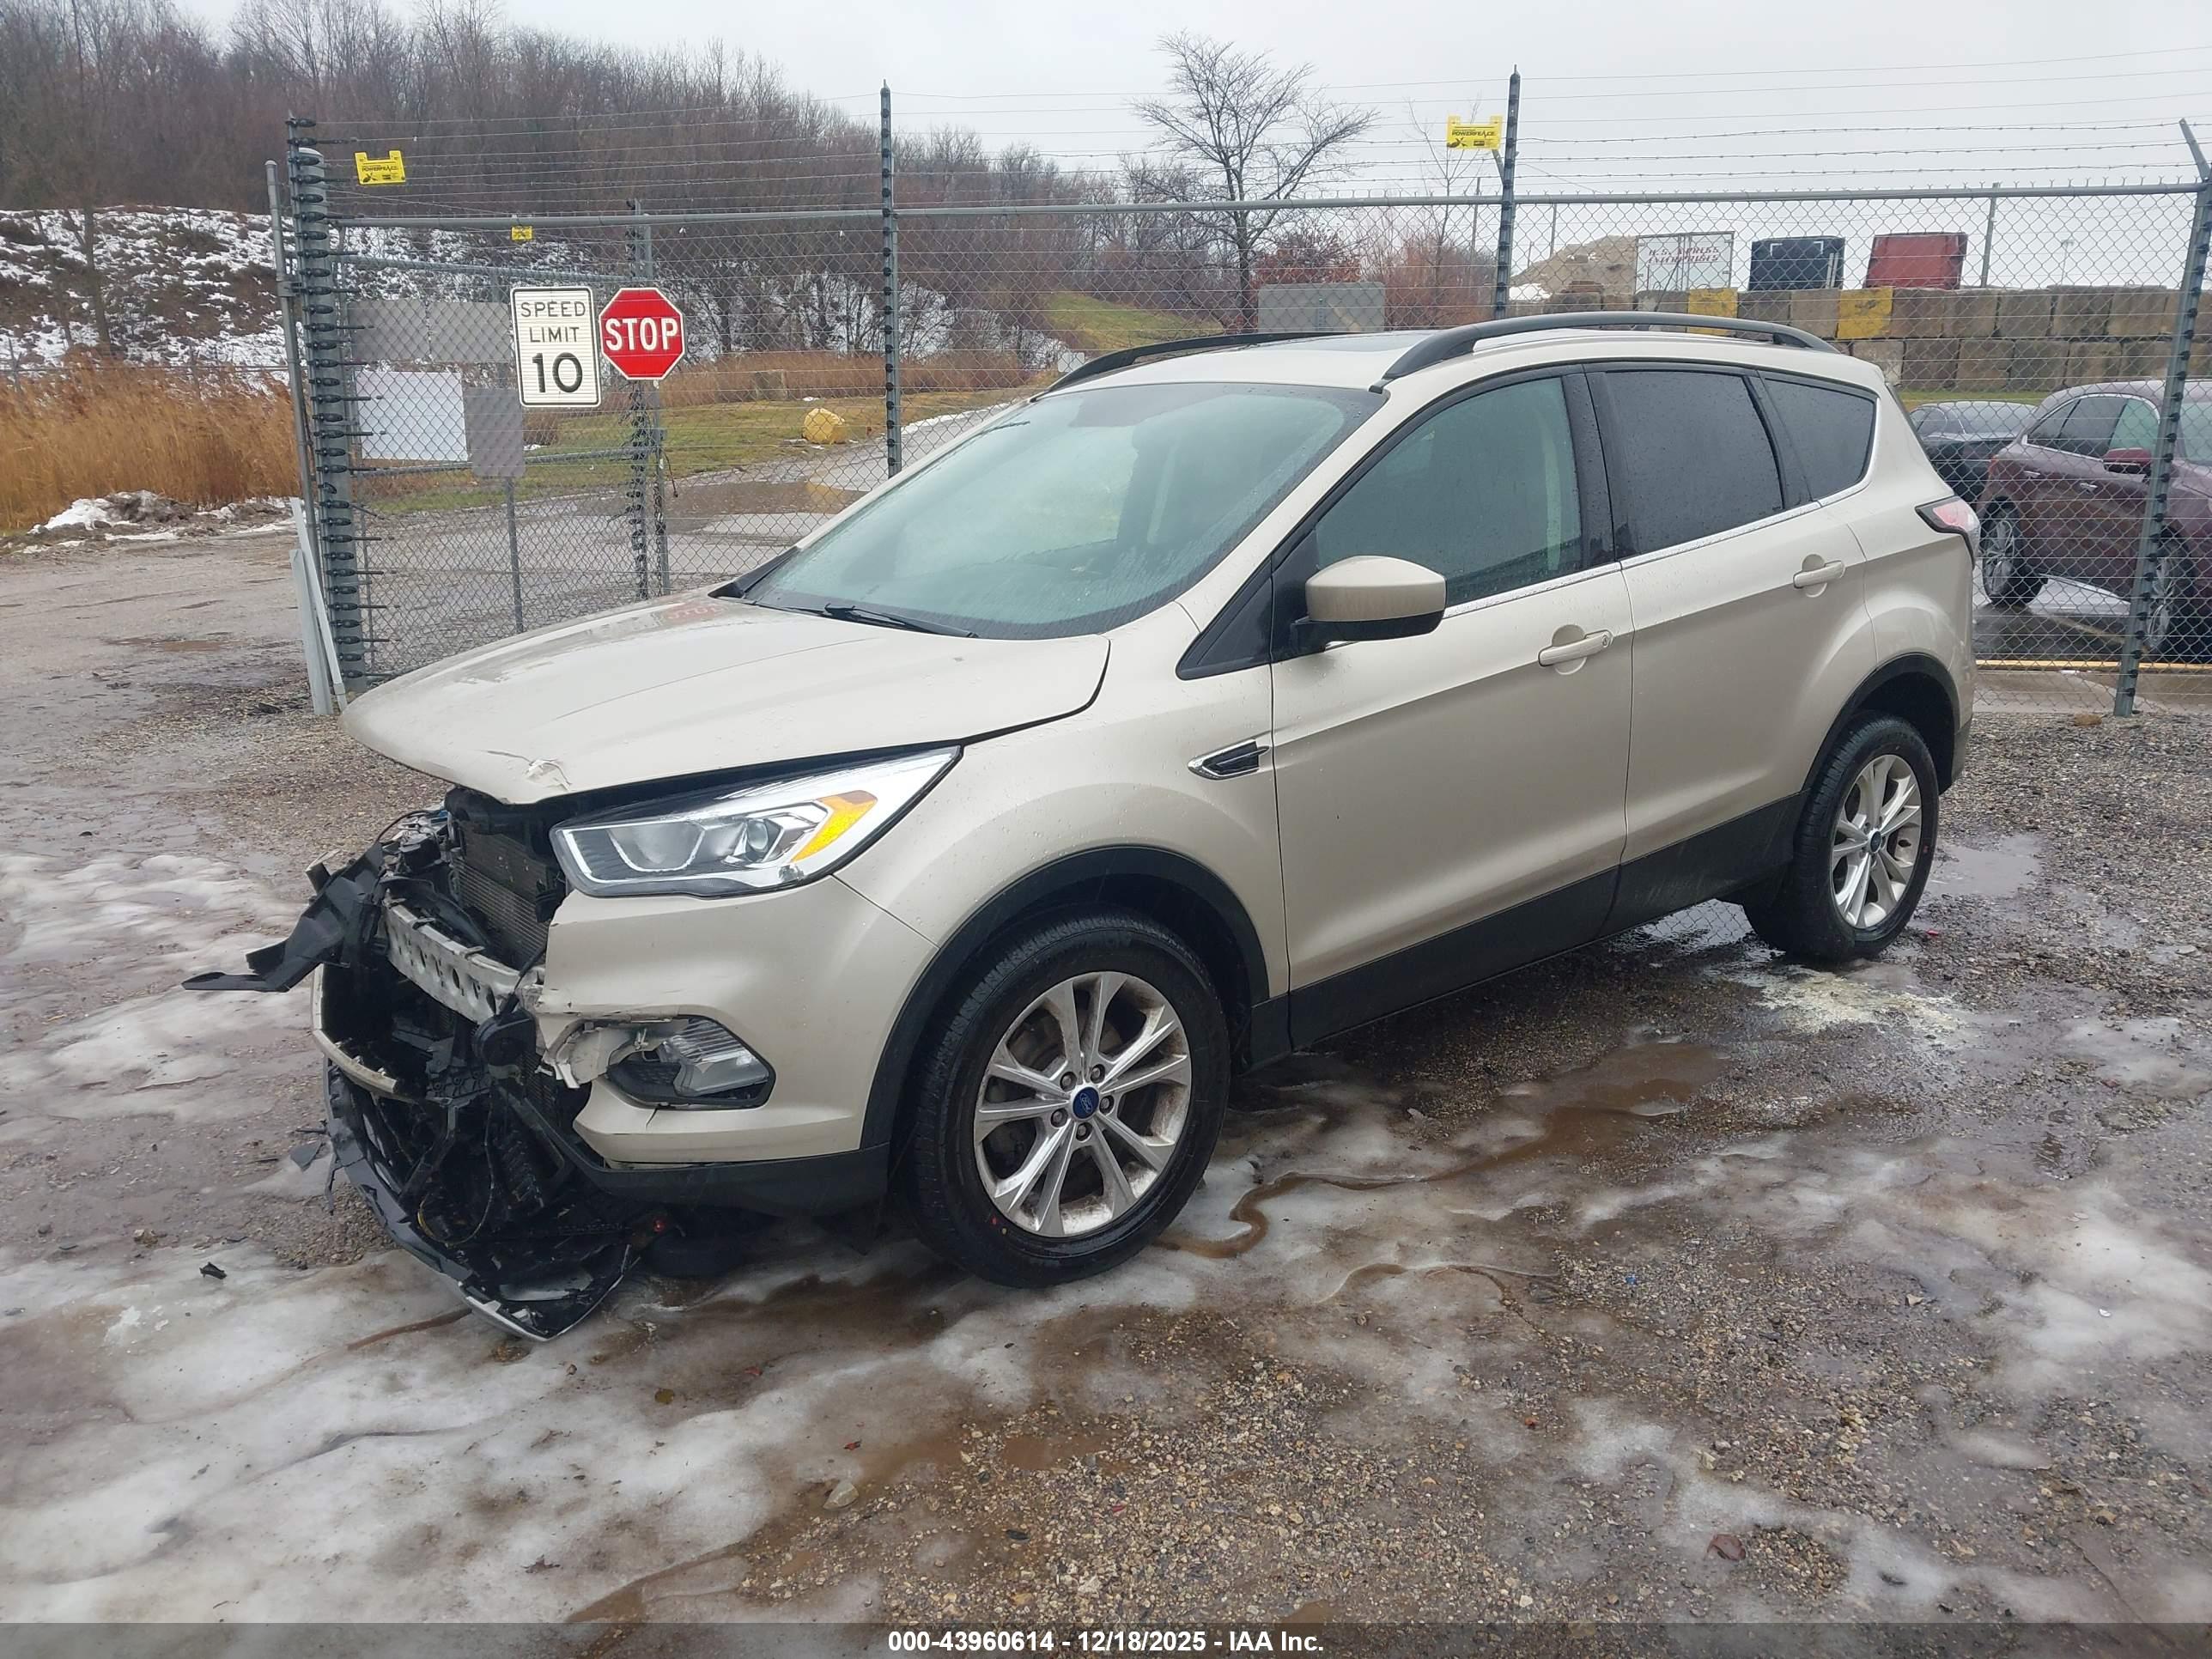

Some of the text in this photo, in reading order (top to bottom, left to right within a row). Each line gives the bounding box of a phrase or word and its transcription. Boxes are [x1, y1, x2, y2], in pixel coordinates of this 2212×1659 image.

[520, 301, 586, 317] SPEED
[529, 326, 580, 343] LIMIT
[605, 317, 678, 351] STOP
[532, 352, 583, 393] 10
